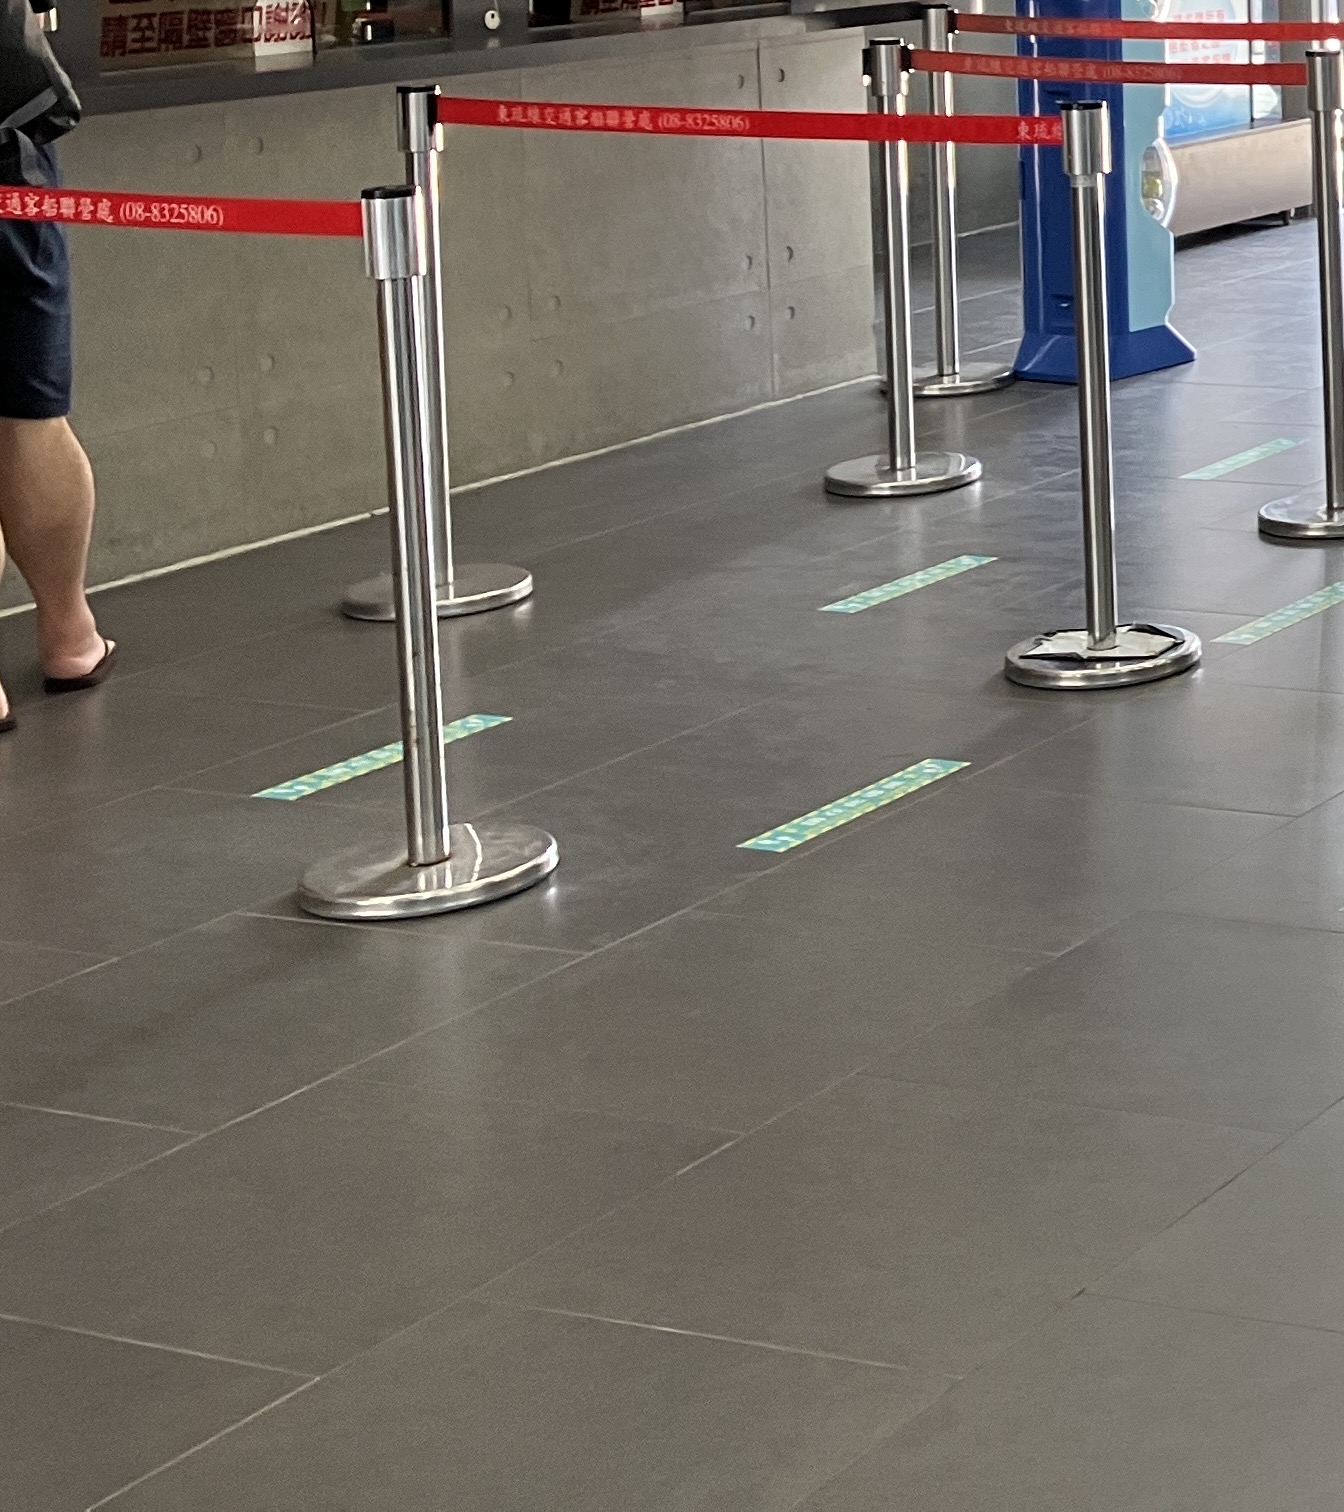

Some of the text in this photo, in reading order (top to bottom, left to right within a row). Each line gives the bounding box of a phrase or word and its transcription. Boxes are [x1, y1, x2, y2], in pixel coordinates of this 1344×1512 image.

[0, 192, 224, 226] 通客船聯營處 (08-8325806)
